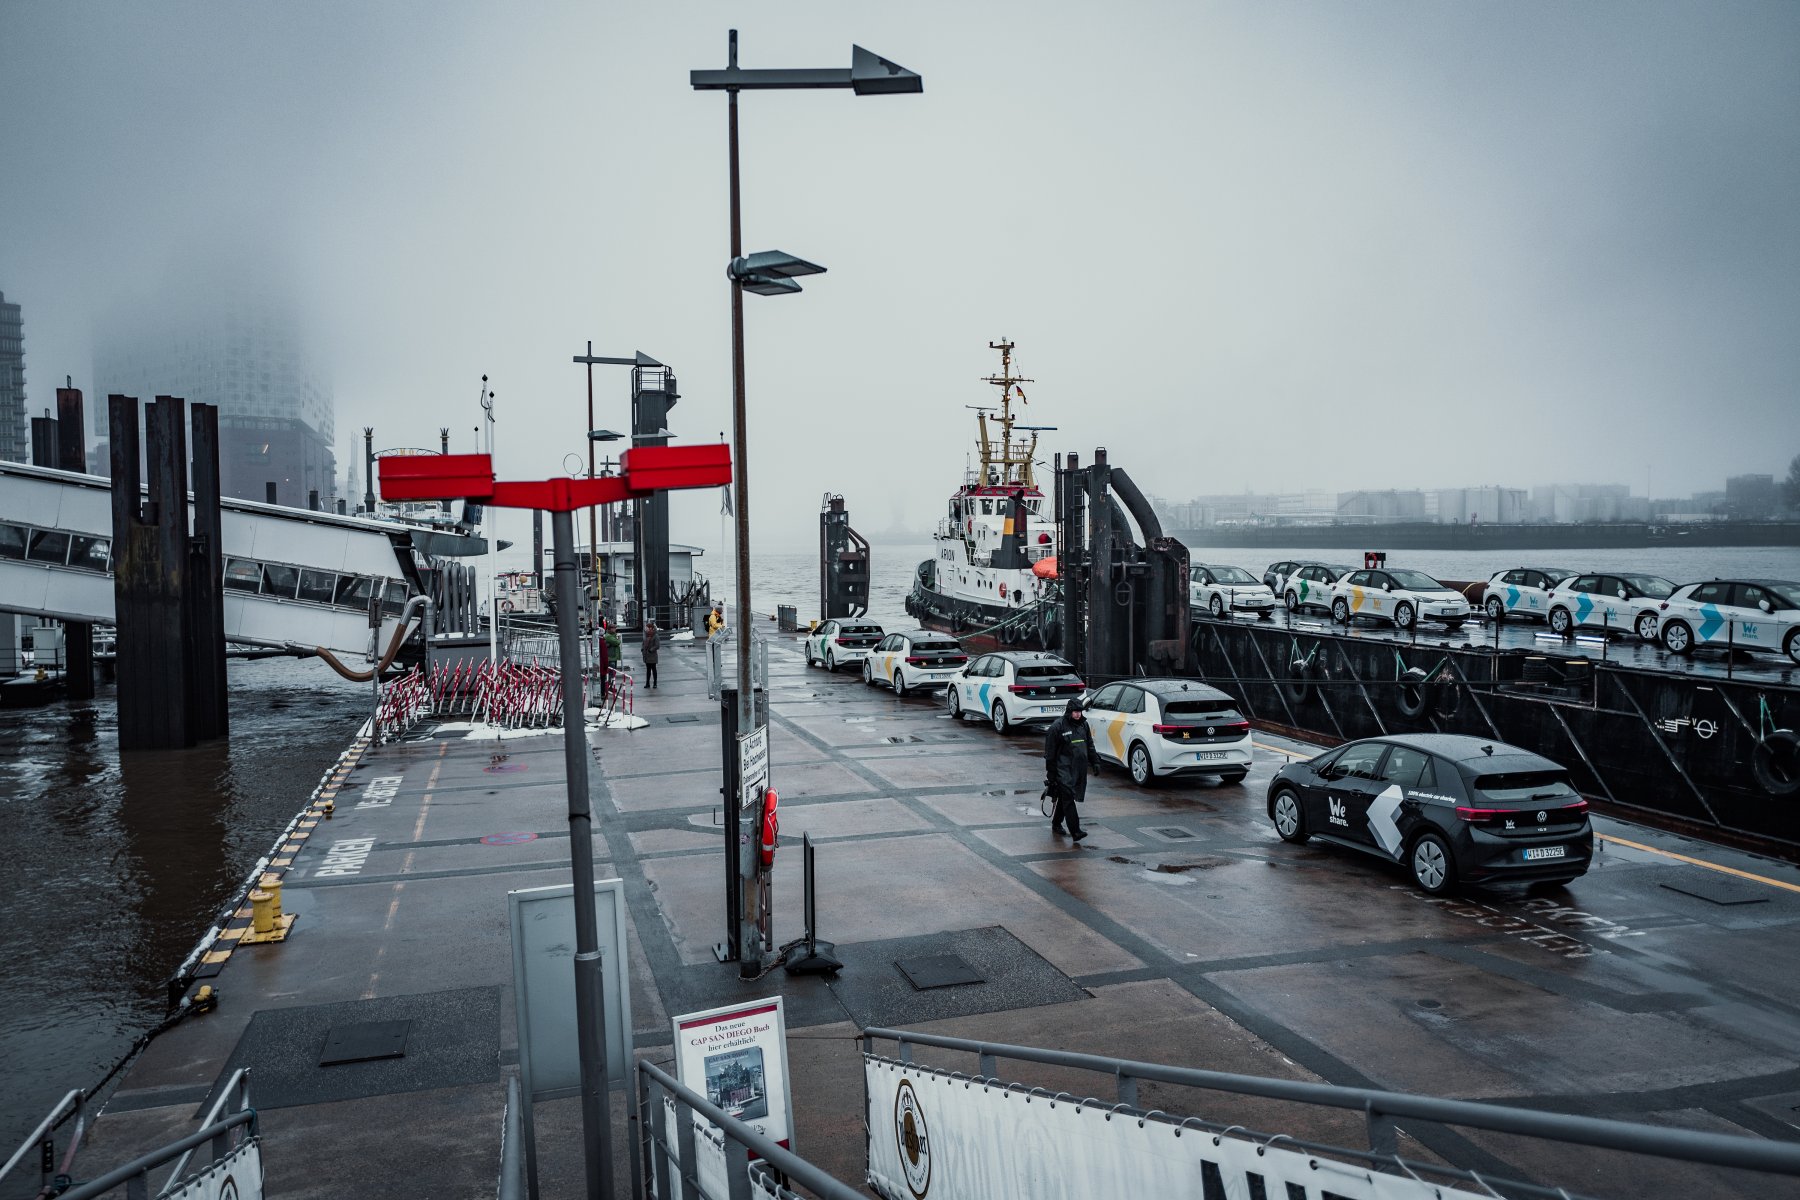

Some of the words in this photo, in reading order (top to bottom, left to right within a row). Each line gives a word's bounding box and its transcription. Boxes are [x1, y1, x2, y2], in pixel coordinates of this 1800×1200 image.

[1742, 621, 1758, 634] We
[354, 775, 404, 810] VERBOTEN
[1328, 796, 1346, 817] We
[1329, 815, 1349, 827] share.
[314, 837, 377, 877] PARKEN
[691, 1036, 708, 1046] CAP
[709, 1033, 726, 1043] SAN
[726, 1028, 752, 1040] DIEGO
[753, 1024, 770, 1034] Buch
[715, 1024, 728, 1033] Das
[729, 1021, 746, 1031] neue
[708, 1043, 722, 1052] hier
[723, 1035, 756, 1049] erhältlich!
